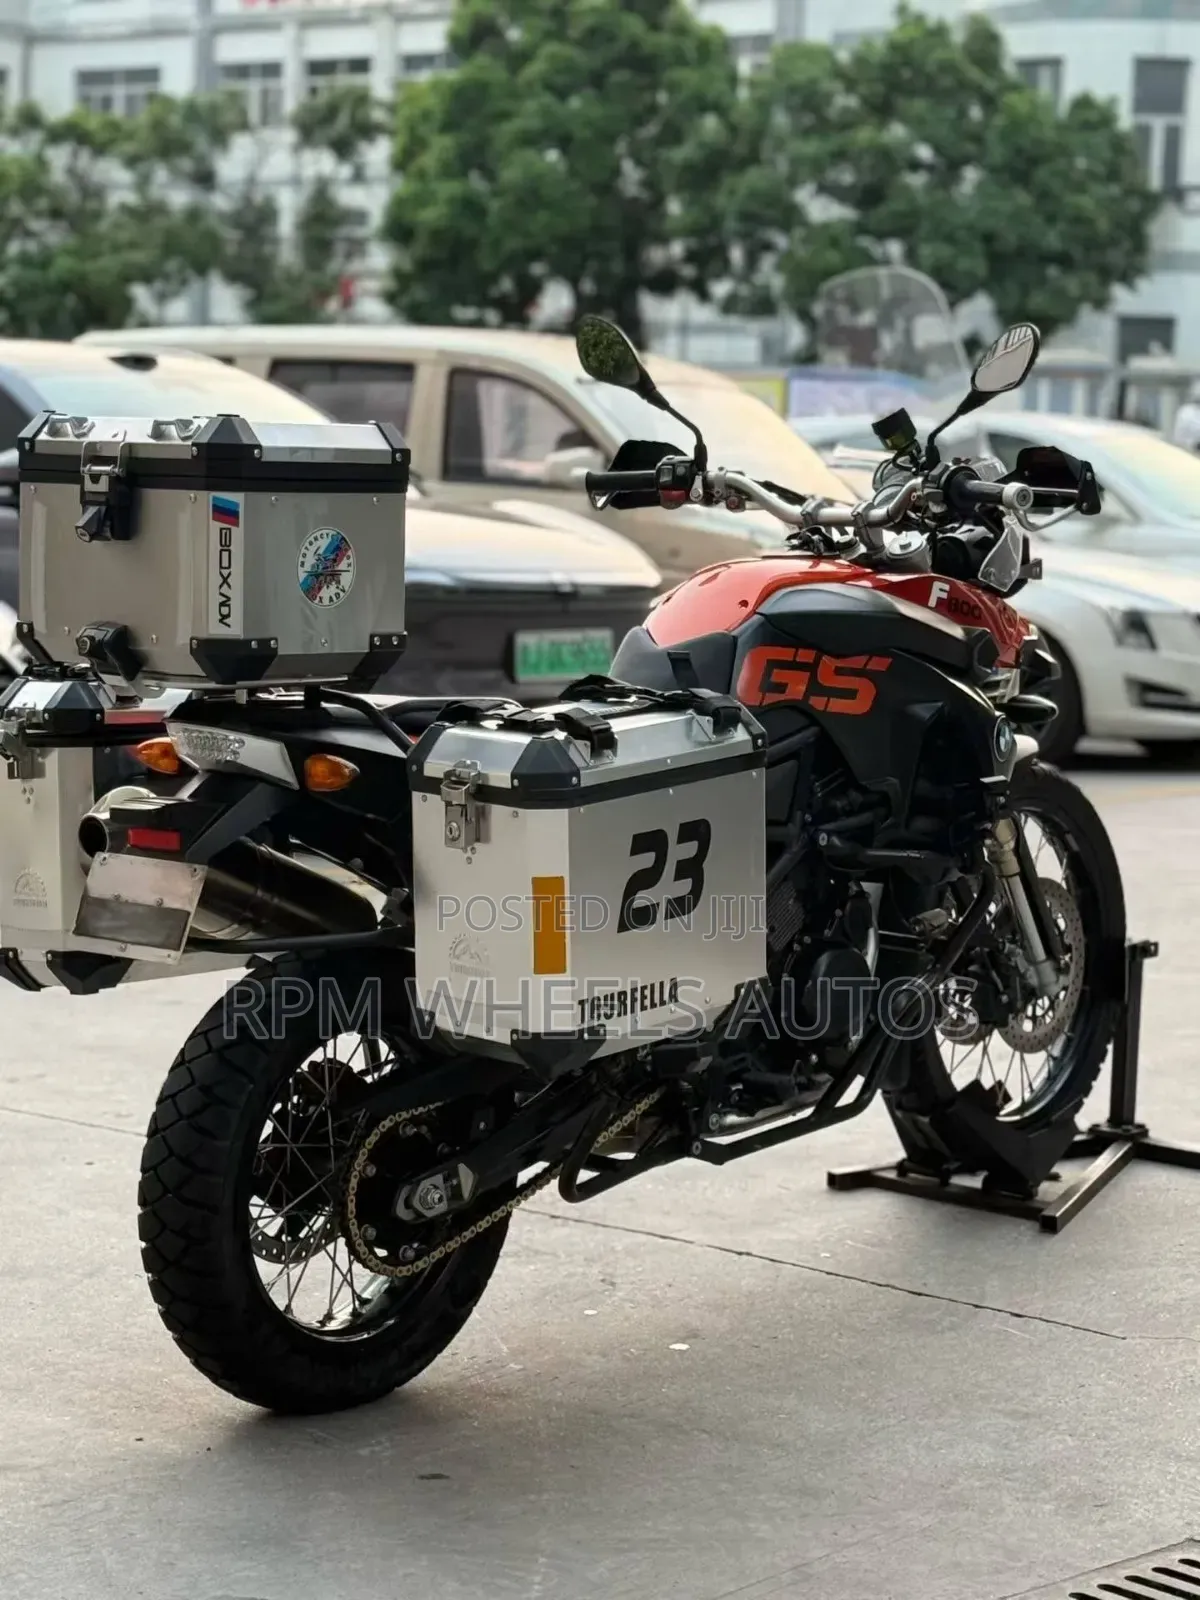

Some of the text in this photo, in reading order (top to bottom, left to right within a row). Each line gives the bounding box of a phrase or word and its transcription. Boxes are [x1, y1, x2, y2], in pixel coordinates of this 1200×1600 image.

[927, 580, 950, 608] F
[736, 645, 894, 715] GS
[616, 818, 711, 934] 23
[577, 977, 680, 1025] TOURFELLA
